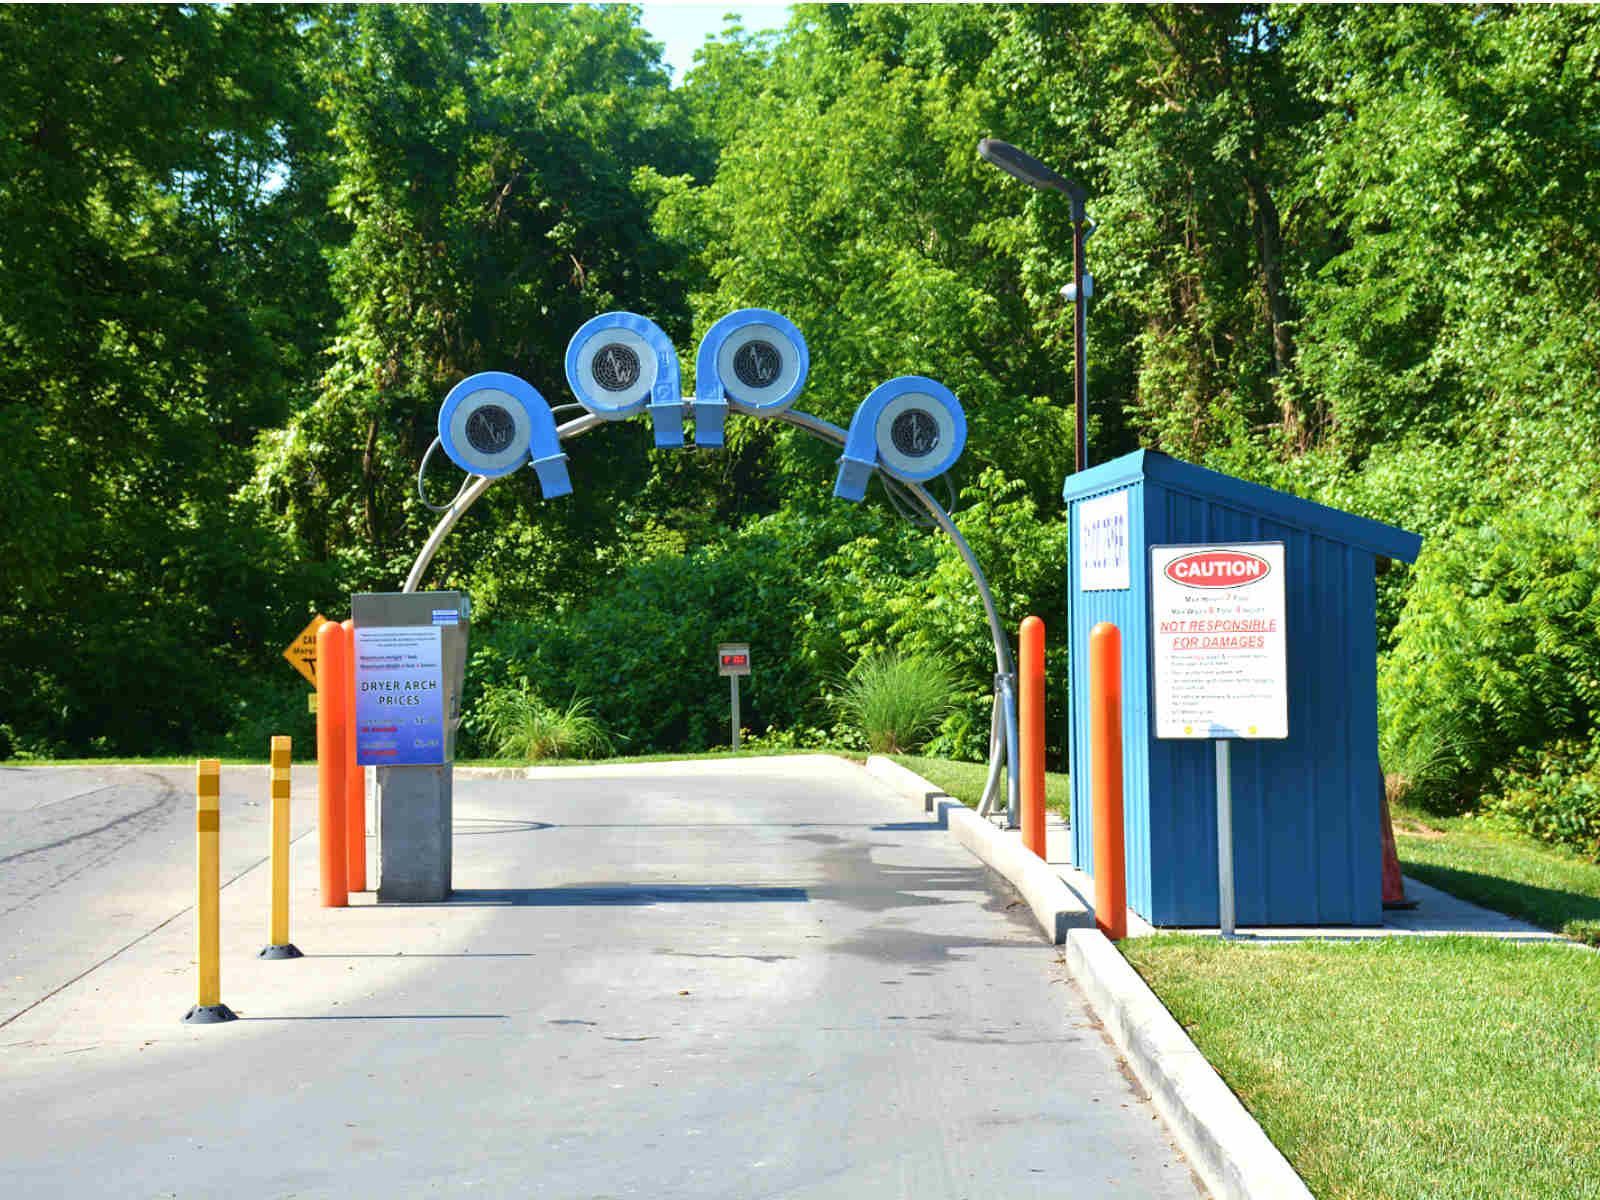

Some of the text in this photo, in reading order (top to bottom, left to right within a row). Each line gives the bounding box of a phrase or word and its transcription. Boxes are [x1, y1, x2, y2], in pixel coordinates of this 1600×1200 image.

[1175, 560, 1260, 577] CAUTION
[1160, 619, 1278, 632] NOT RESPONSIBLE
[1173, 636, 1265, 648] FOR DAMAGES
[361, 680, 437, 692] DRYER ARCH
[378, 695, 420, 705] PRICES
